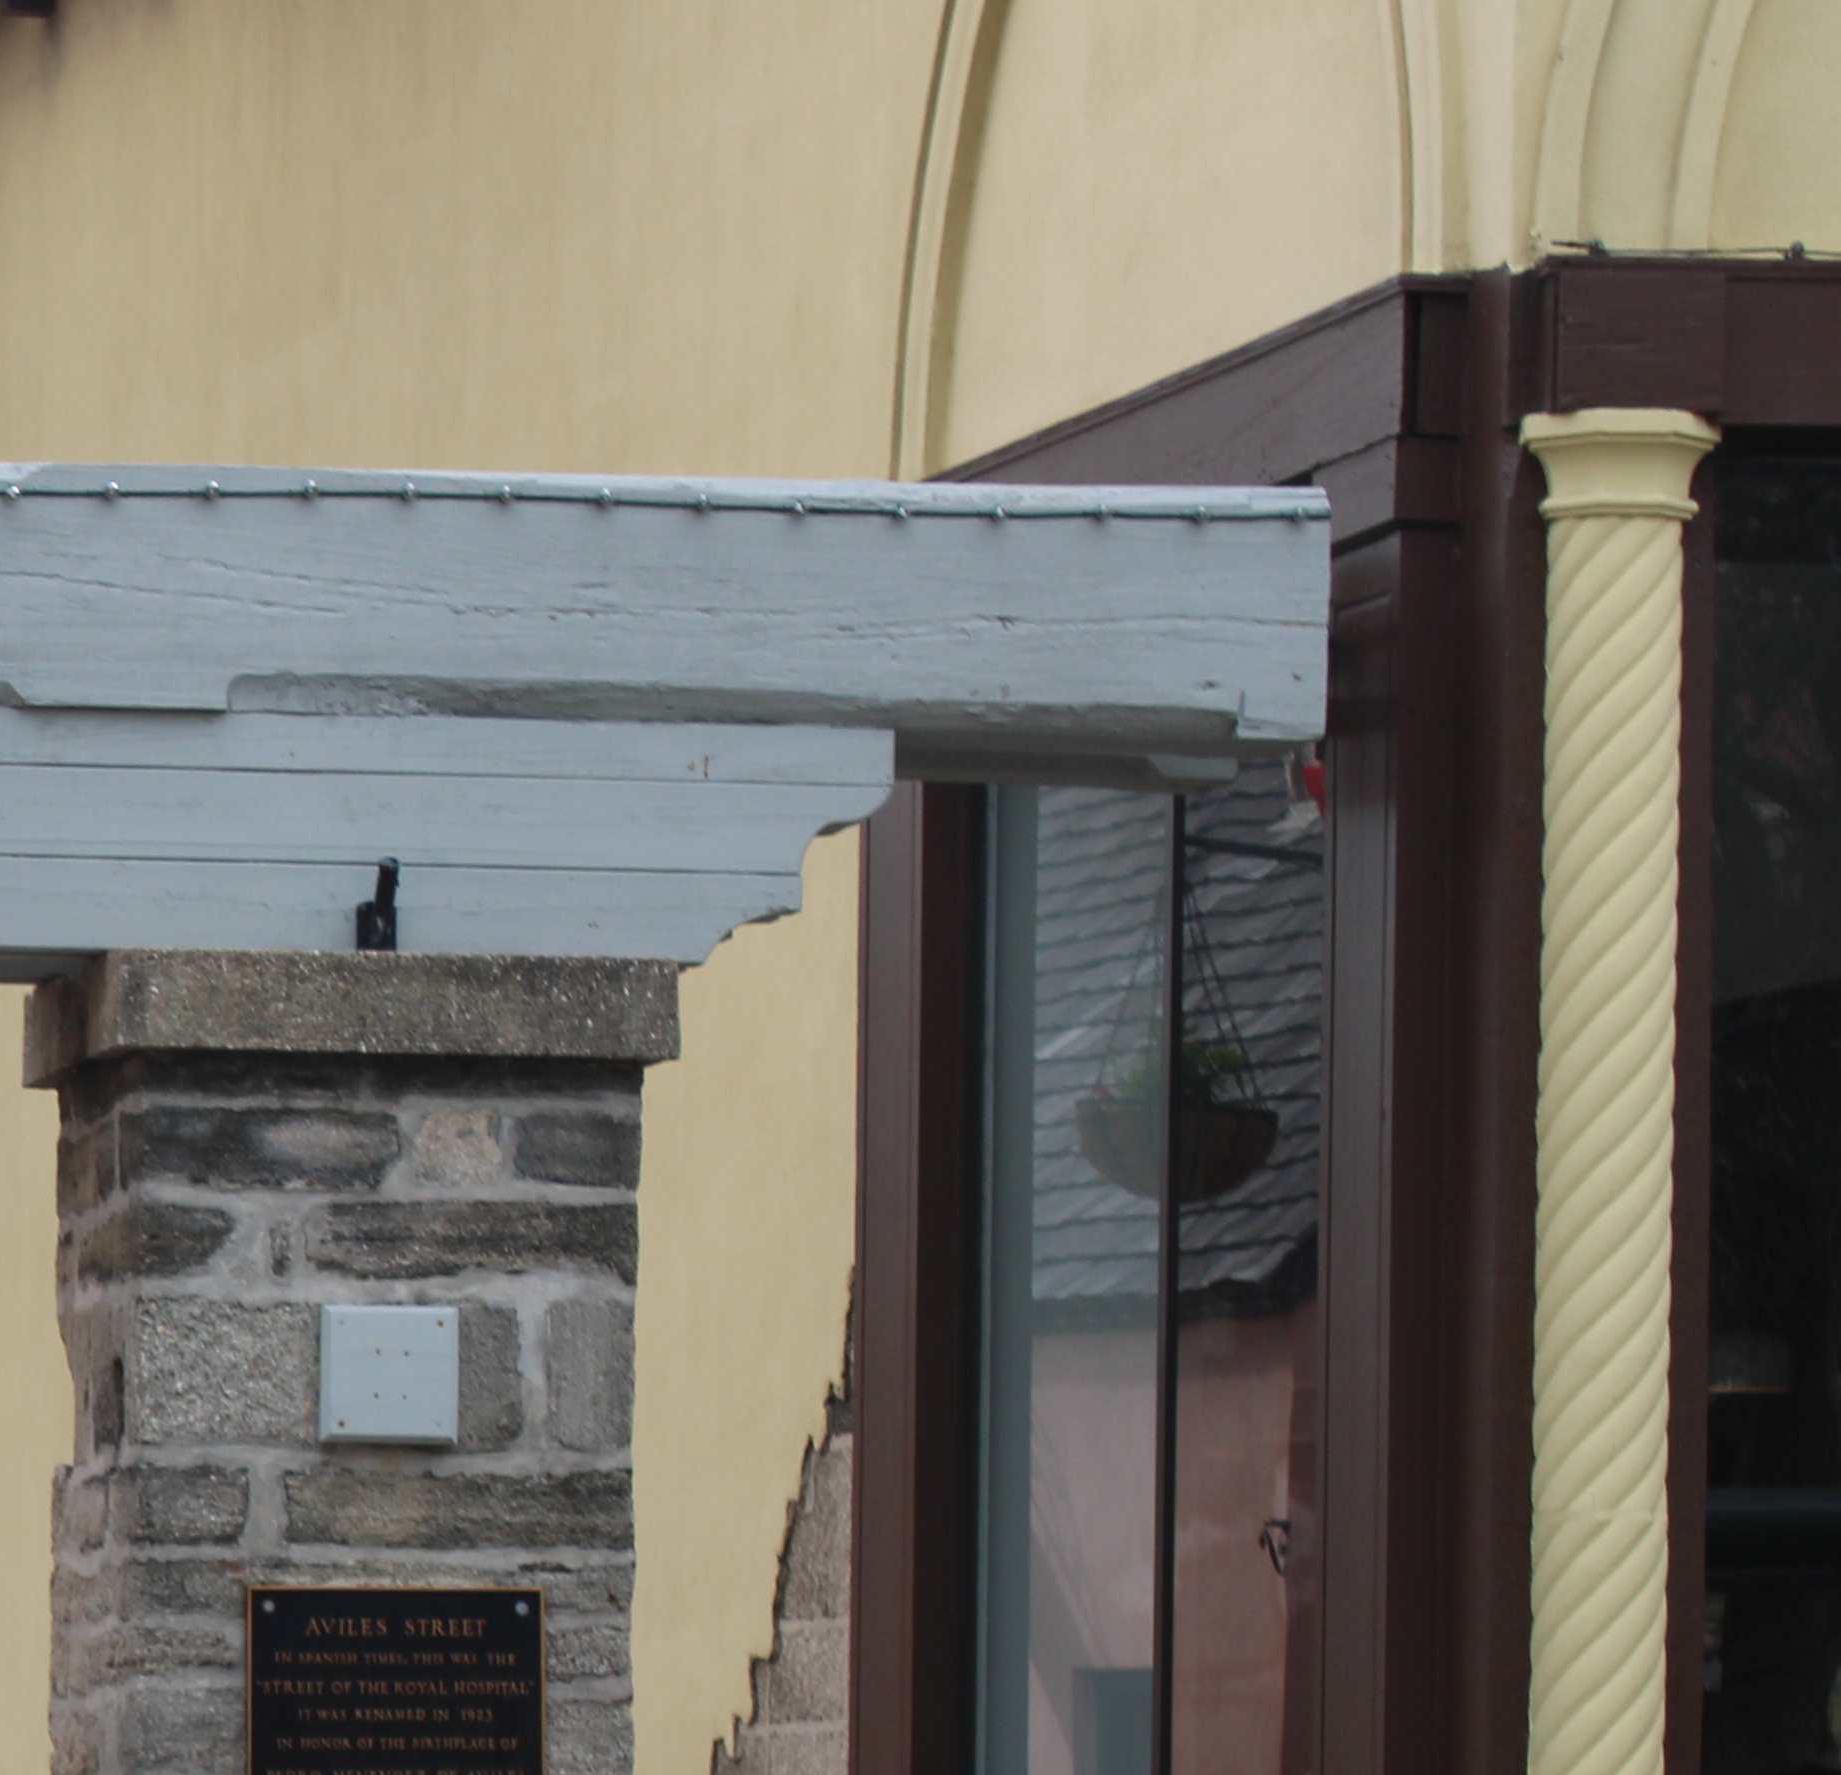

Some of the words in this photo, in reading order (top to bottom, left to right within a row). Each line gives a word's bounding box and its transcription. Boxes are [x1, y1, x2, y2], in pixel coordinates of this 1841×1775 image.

[305, 1617, 388, 1637] AVILES
[405, 1618, 487, 1637] STREET
[274, 1651, 292, 1664] IN
[299, 1652, 357, 1665] SPANISH
[413, 1653, 445, 1666] THIS
[450, 1653, 478, 1666] WAS
[487, 1653, 517, 1667] THE
[331, 1680, 353, 1695] OF
[358, 1680, 390, 1695] THE
[394, 1680, 448, 1696] ROYAL
[298, 1708, 312, 1721] IT
[318, 1708, 347, 1721] WAS
[355, 1708, 426, 1721] RENAMED
[433, 1708, 450, 1721] IN
[276, 1737, 293, 1750] IN
[300, 1737, 351, 1750] HONOR
[357, 1737, 374, 1750] OF
[380, 1737, 406, 1750] THE
[412, 1737, 495, 1750] BIRTHPLACE
[501, 1737, 519, 1750] OF
